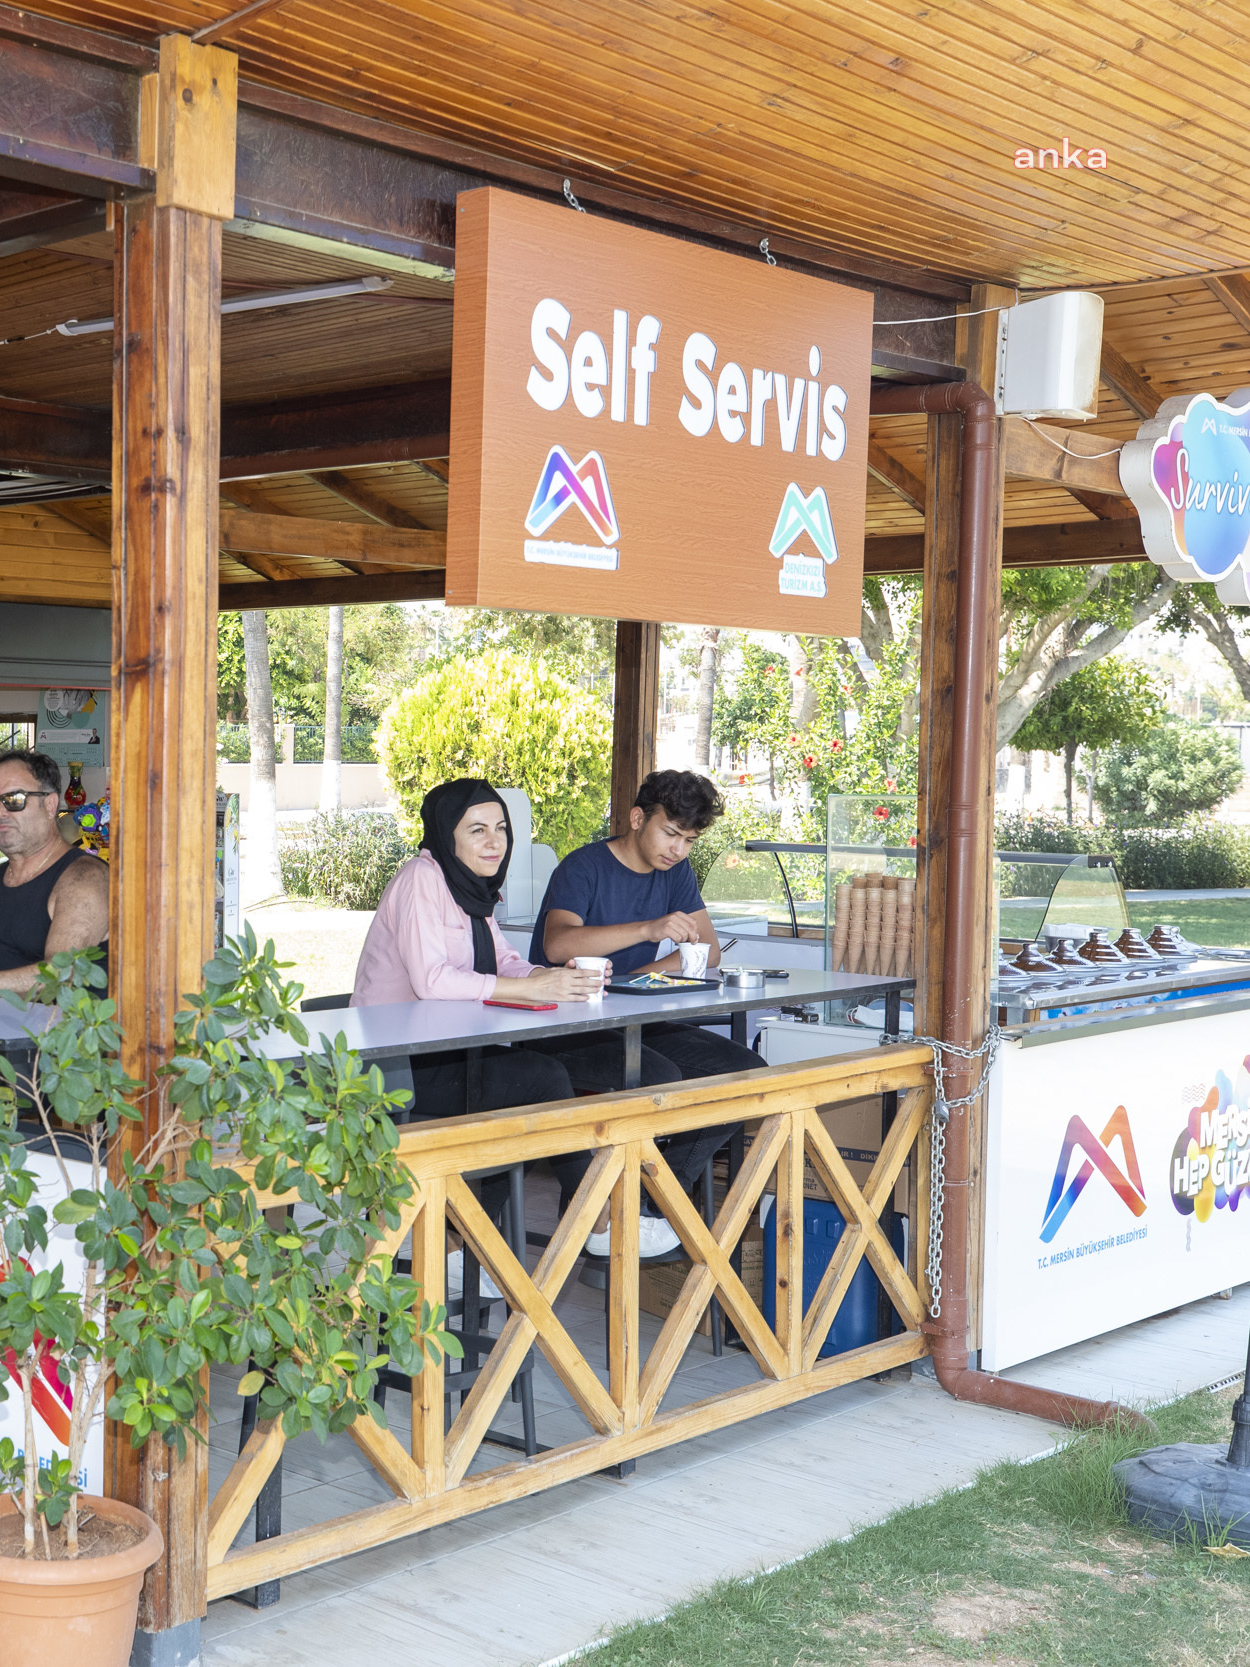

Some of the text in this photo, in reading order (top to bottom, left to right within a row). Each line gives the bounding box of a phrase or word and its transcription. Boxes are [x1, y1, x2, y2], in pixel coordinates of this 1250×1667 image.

[526, 297, 849, 462] Self Servis
[780, 575, 808, 591] TURİZM
[784, 559, 821, 577] DENİZKIZI
[1173, 1148, 1250, 1197] HEP GÜZ
[1037, 1224, 1148, 1270] T.C. MERSİN BÜYÜKŞEHİR BELEDİYESİ
